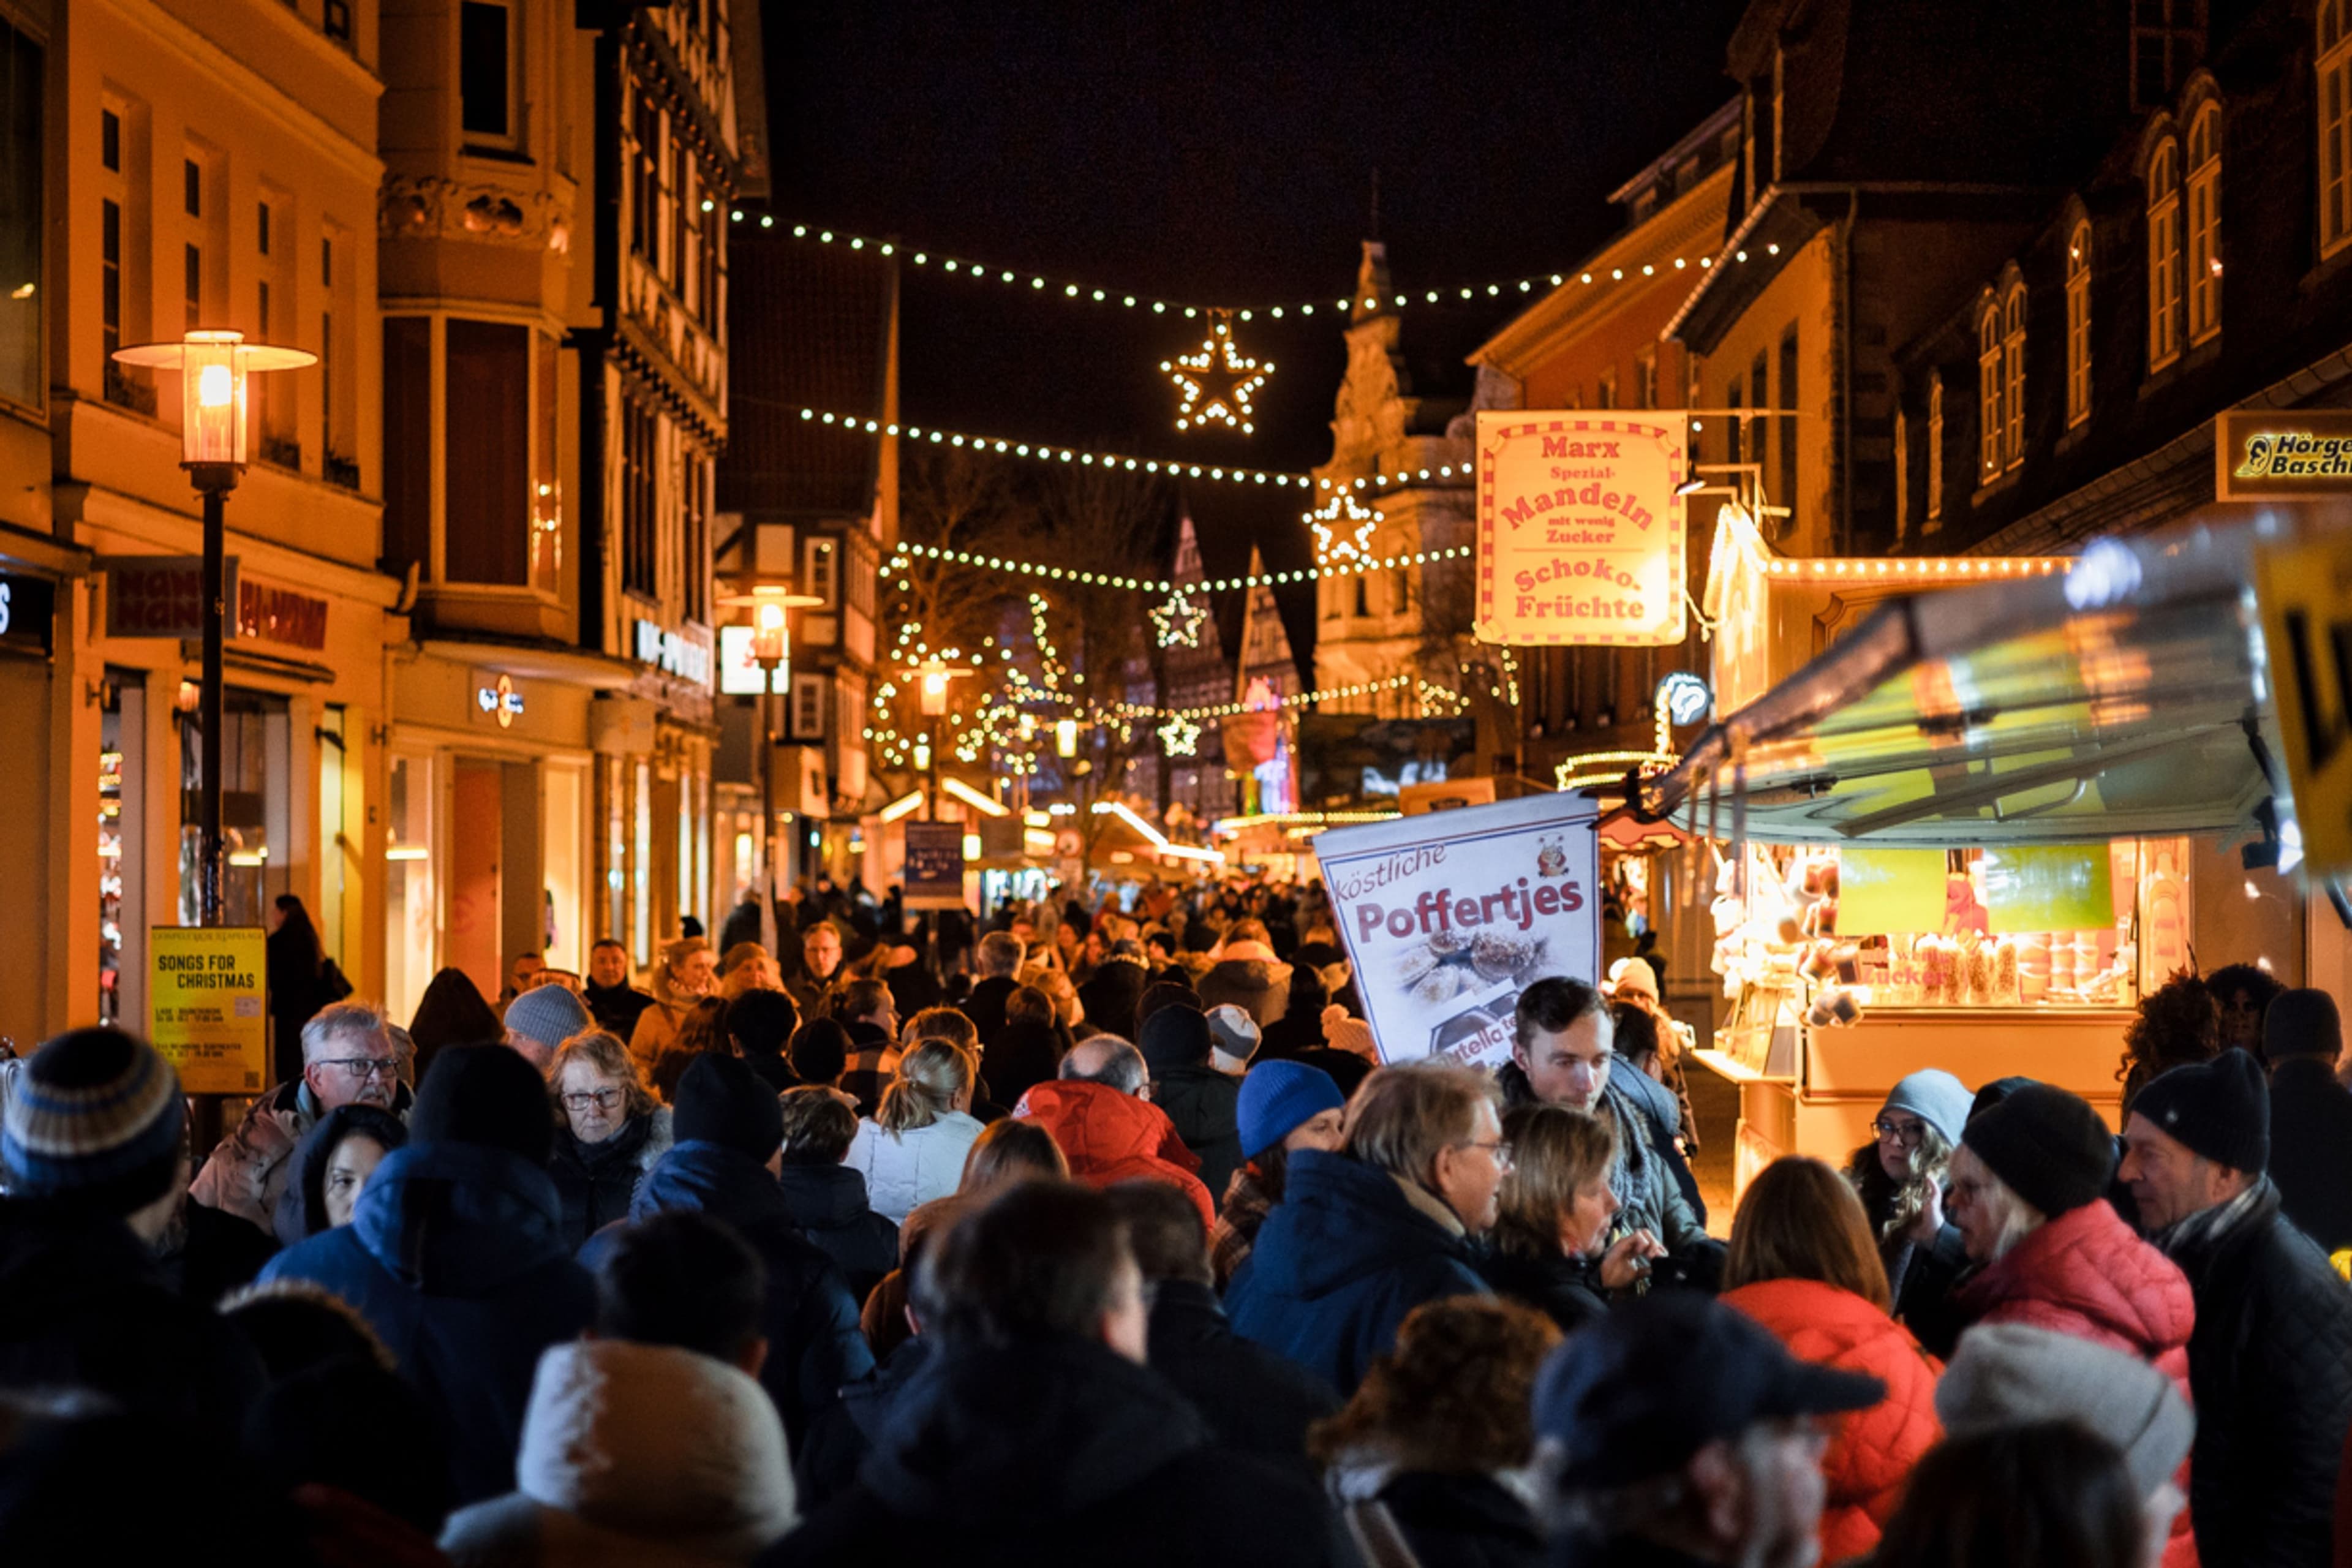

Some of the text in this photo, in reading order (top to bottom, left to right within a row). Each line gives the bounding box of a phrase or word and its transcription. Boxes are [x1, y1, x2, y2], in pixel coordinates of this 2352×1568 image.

[1541, 435, 1621, 459] Marx
[1550, 466, 1616, 481] Spezial-
[2271, 455, 2352, 473] Basch
[1501, 482, 1654, 532] Mandeln
[1547, 516, 1616, 528] mit wenig
[1546, 529, 1616, 544] Zucker
[1514, 594, 1645, 619] Früchte
[1333, 842, 1447, 904] köstliche
[1356, 876, 1585, 944] Poffertjes
[158, 954, 236, 971] SONGS FOR
[177, 972, 255, 989] CHRISTMAS
[1862, 966, 1948, 986] Zucker
